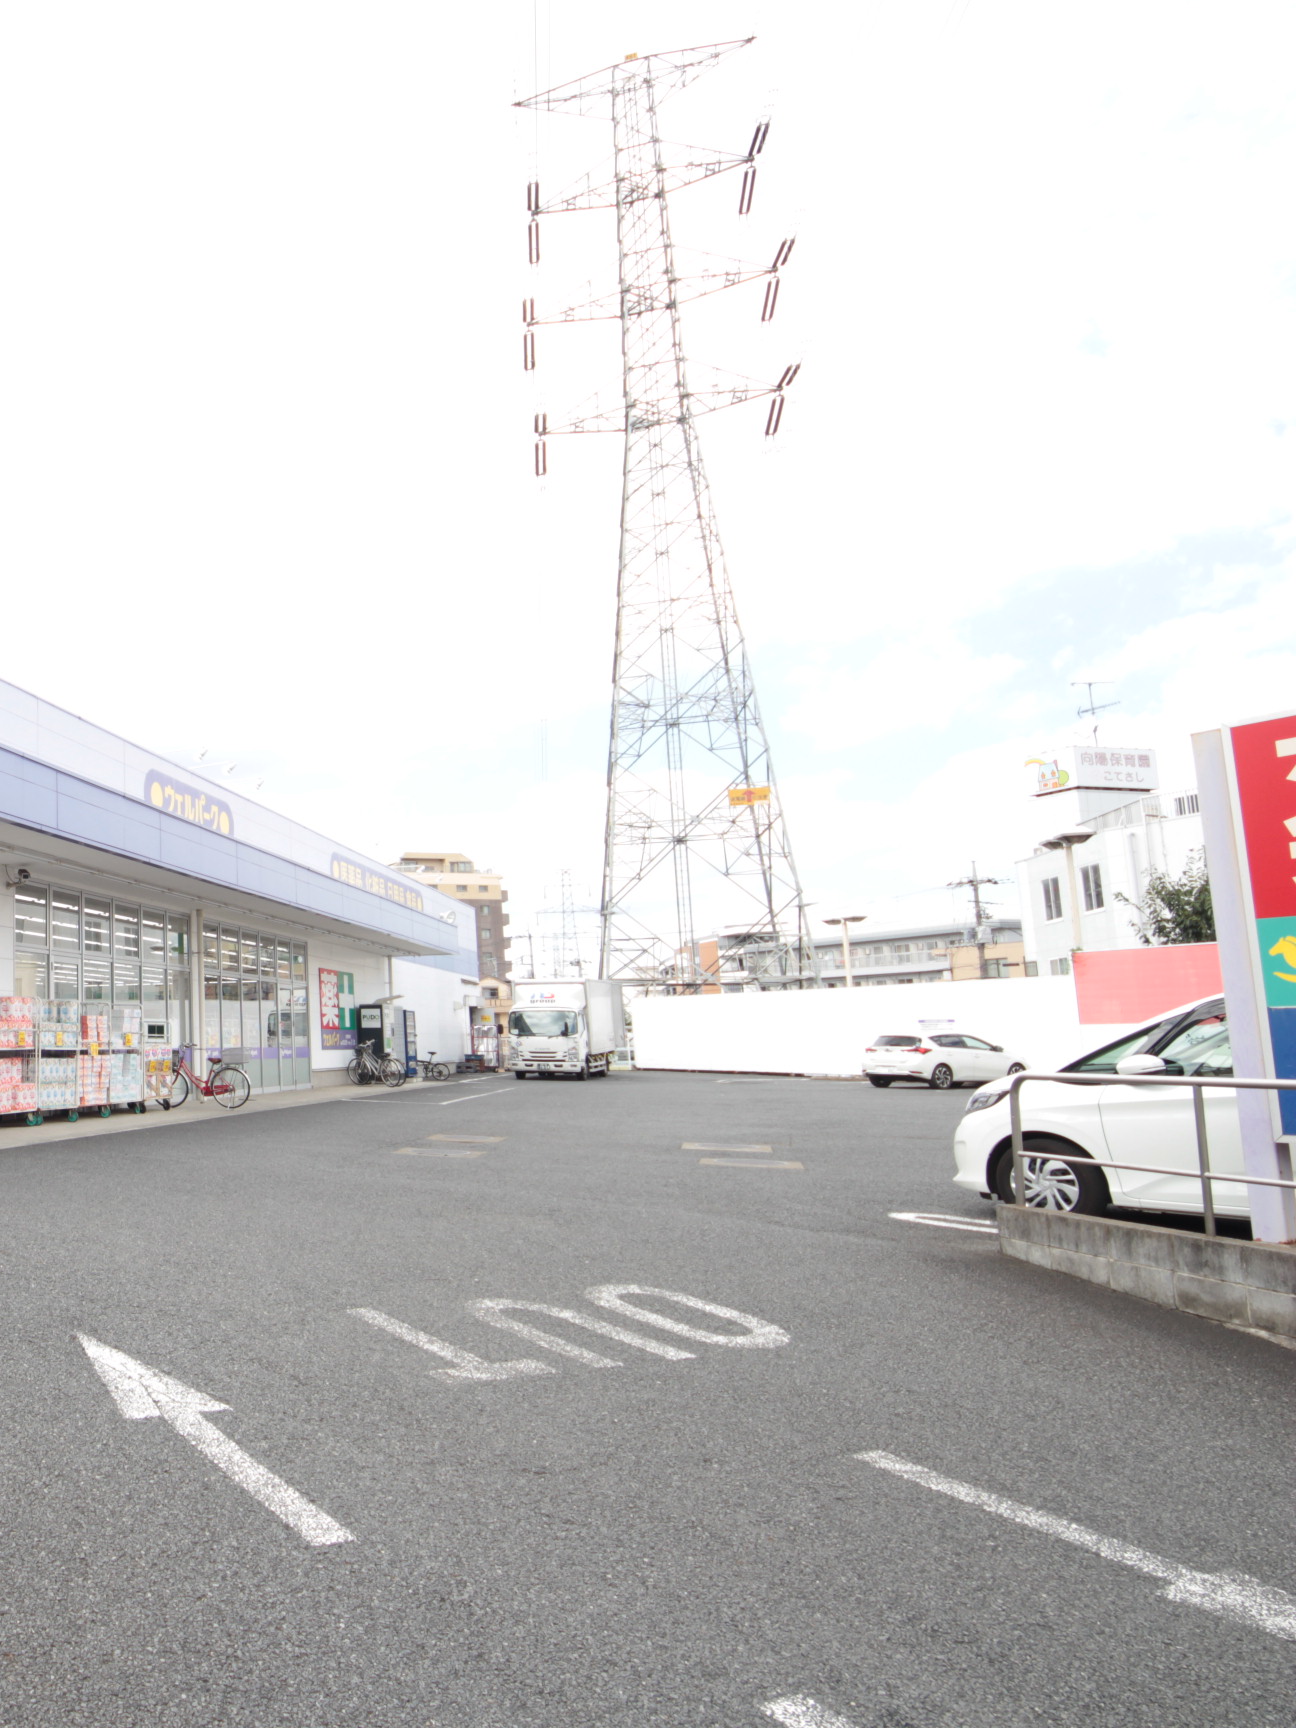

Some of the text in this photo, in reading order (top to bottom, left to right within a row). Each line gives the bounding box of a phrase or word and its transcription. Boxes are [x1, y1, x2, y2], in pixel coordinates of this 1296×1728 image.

[1104, 771, 1144, 783] こてさし
[321, 971, 339, 1027] 薬
